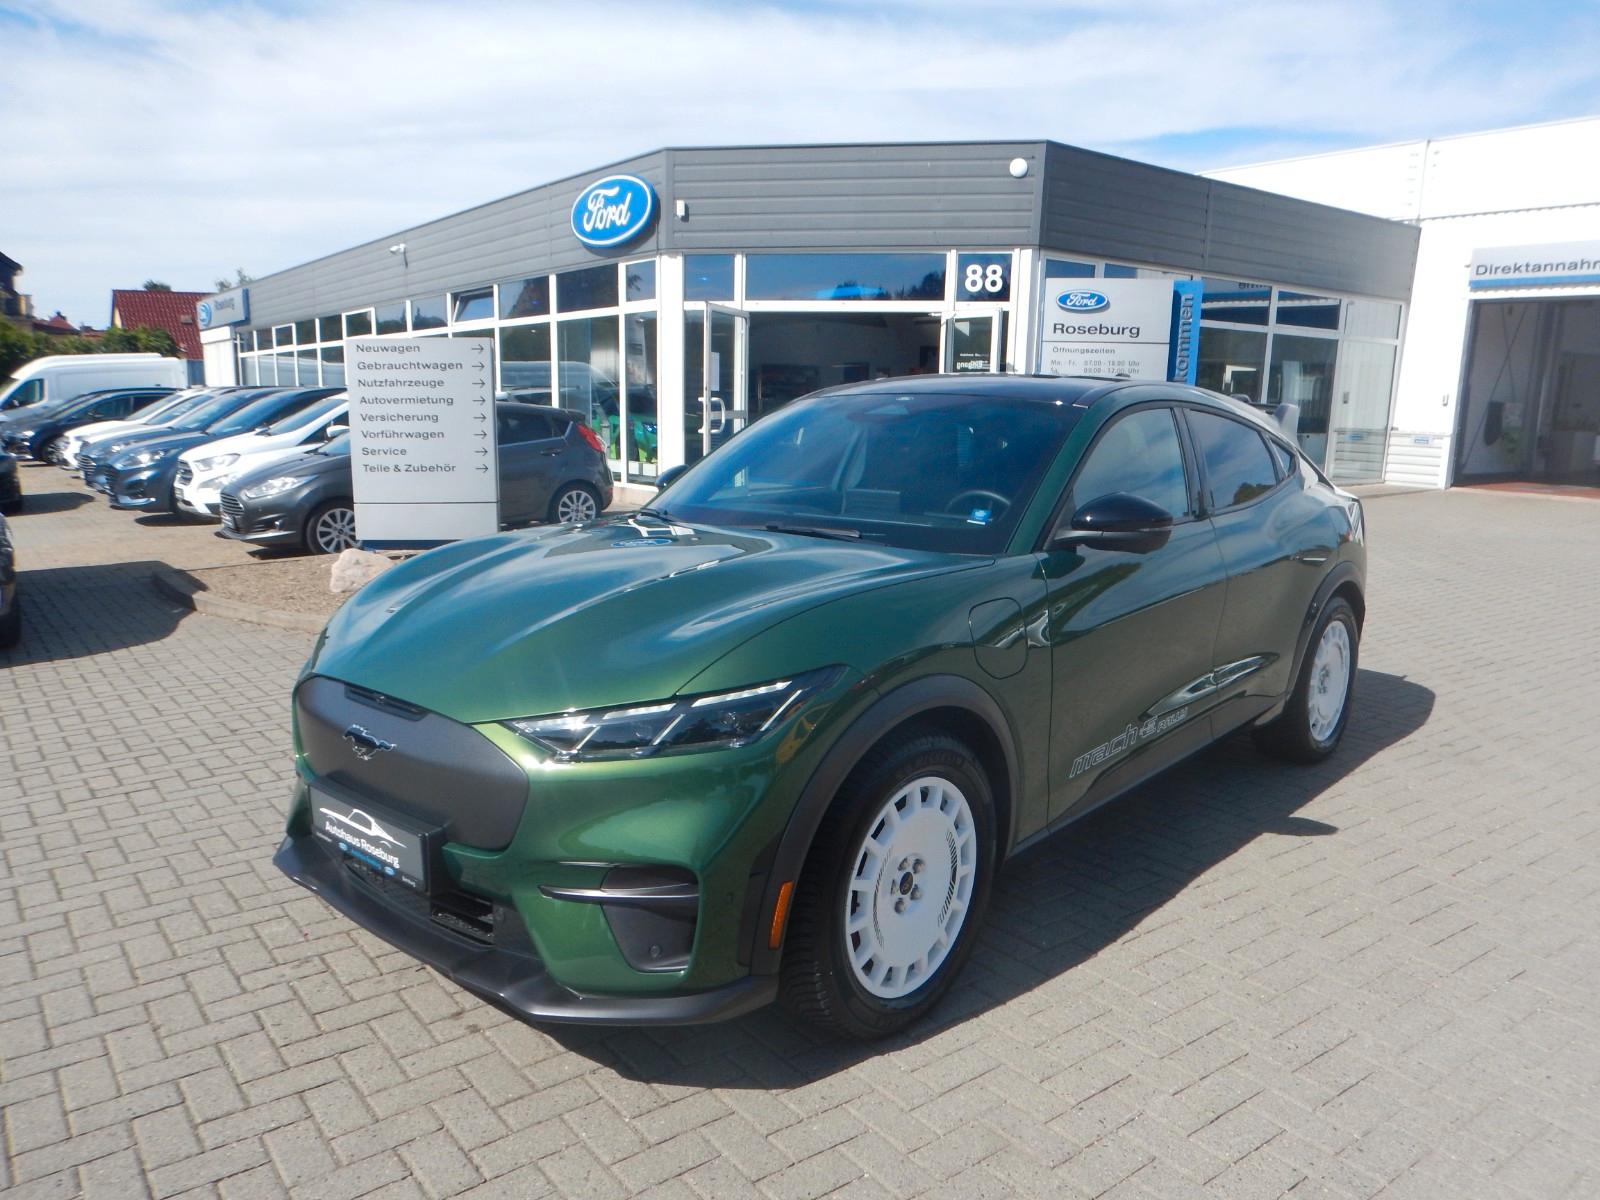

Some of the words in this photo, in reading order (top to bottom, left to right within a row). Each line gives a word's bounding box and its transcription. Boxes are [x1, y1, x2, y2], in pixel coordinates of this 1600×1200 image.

[583, 186, 632, 232] Ford
[964, 264, 1003, 293] 88
[1066, 292, 1099, 306] Ford
[1053, 323, 1140, 338] Roseburg
[356, 344, 421, 354] Neuwagen
[1052, 346, 1116, 355] Öffnungszeiten
[357, 361, 463, 371] Gebrauchtwagen
[358, 379, 445, 389] Nutzfahrzeuge
[360, 396, 454, 406] Autovermietung
[360, 413, 439, 423] Versicherung
[361, 430, 445, 440] Vorführwagen
[362, 447, 407, 456] Service
[363, 464, 390, 473] Teile
[393, 464, 402, 473] &
[404, 464, 456, 473] Zubehör
[325, 821, 361, 847] Autohaus
[361, 839, 399, 868] Roseburg
